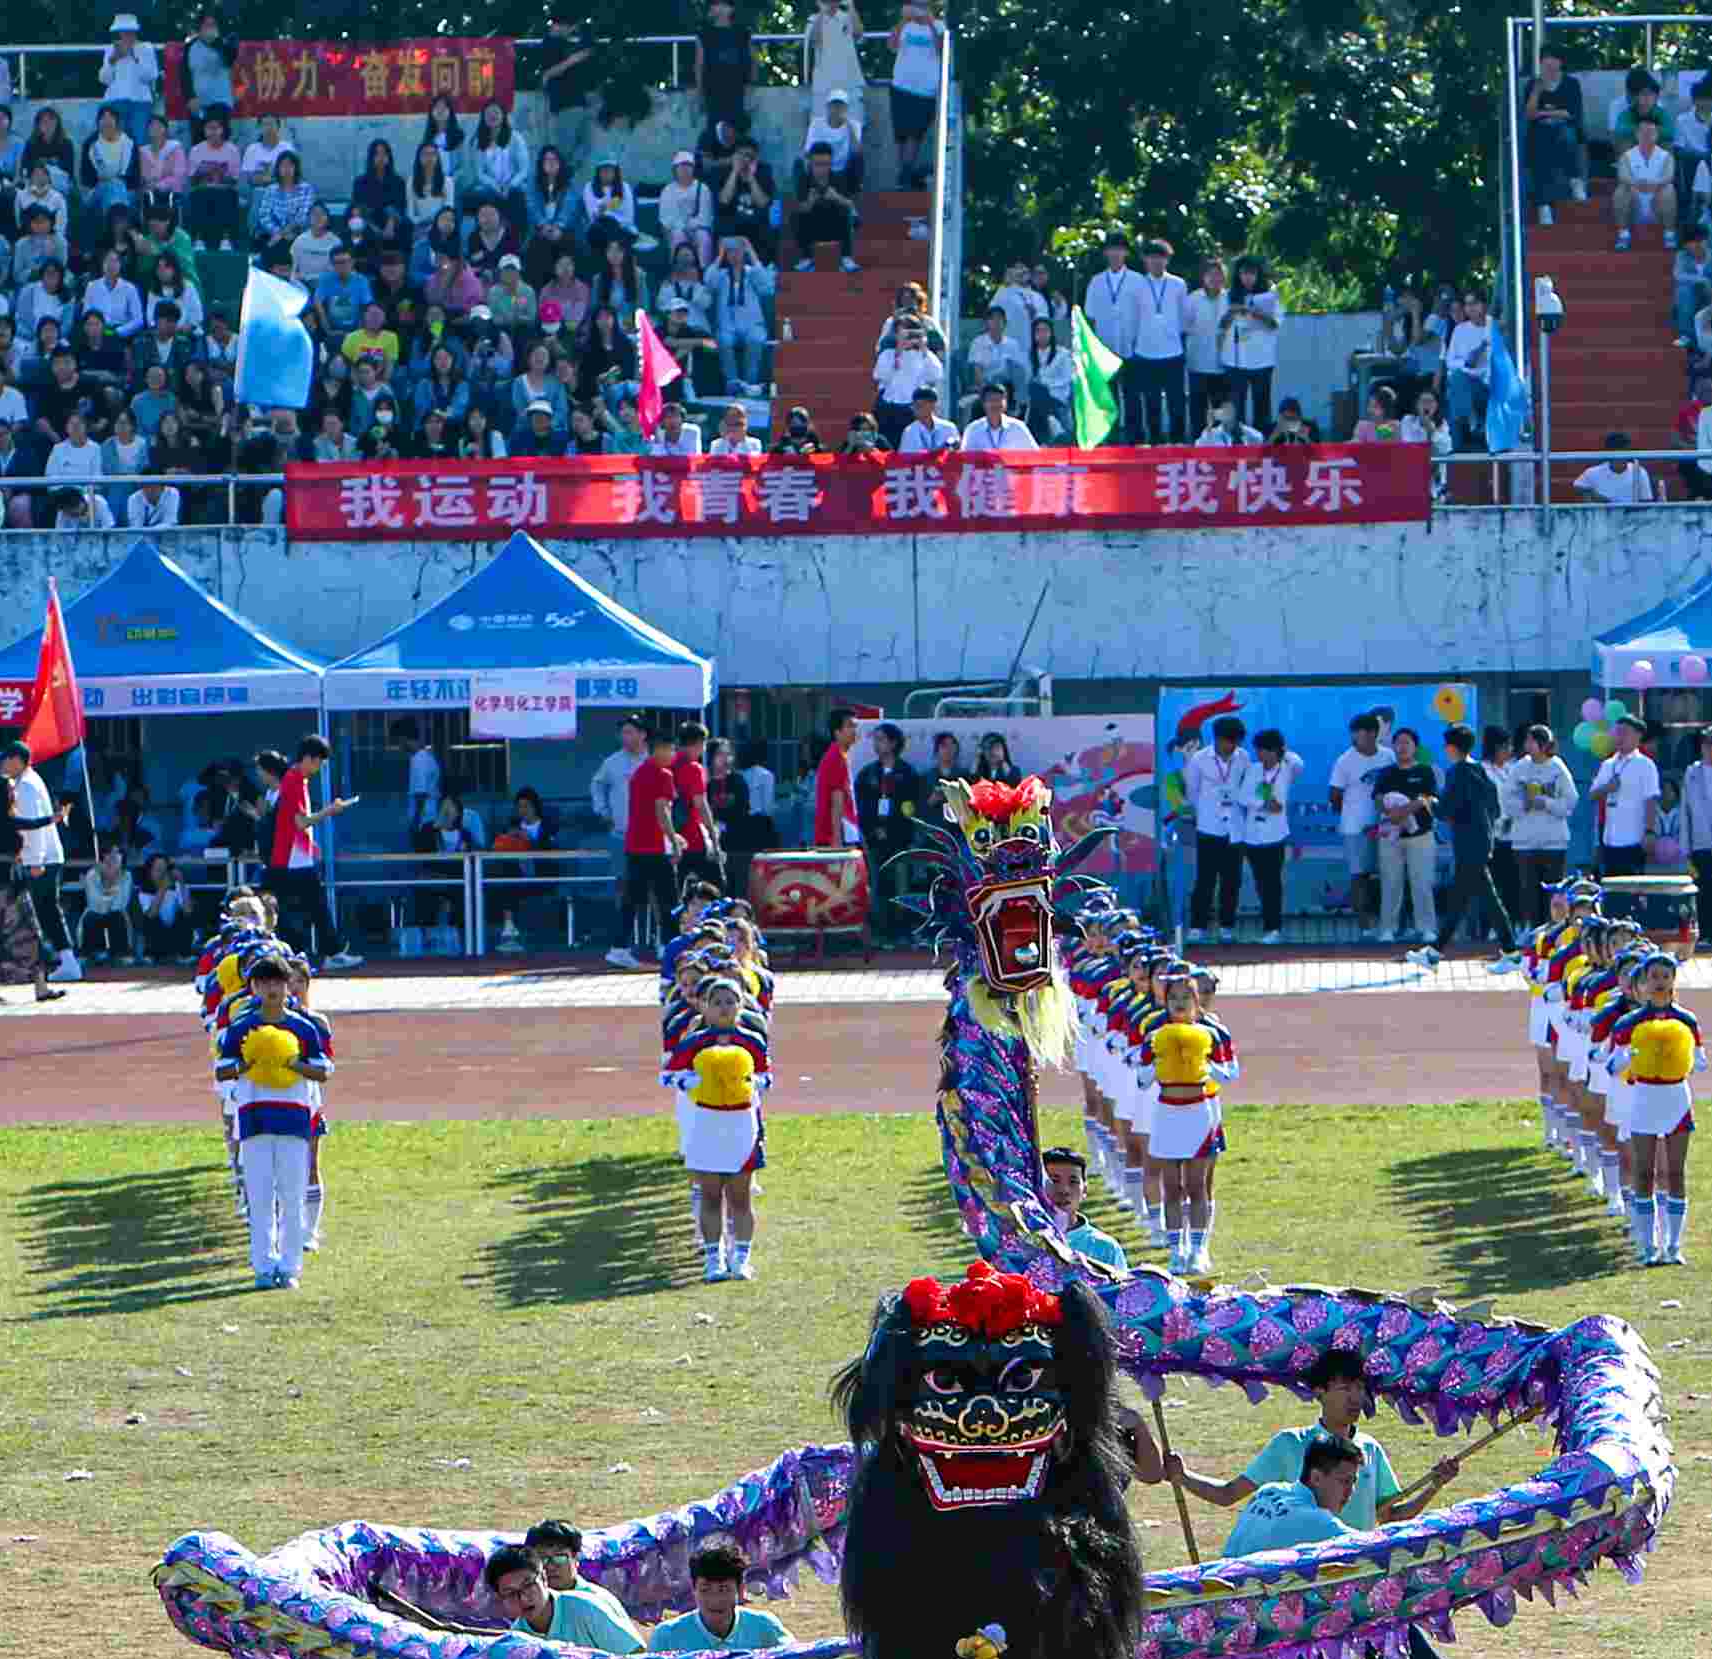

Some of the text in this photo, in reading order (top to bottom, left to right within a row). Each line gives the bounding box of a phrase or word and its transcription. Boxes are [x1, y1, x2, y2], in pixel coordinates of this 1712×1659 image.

[340, 457, 1364, 529] 我运动 我青春 我健康 我快乐
